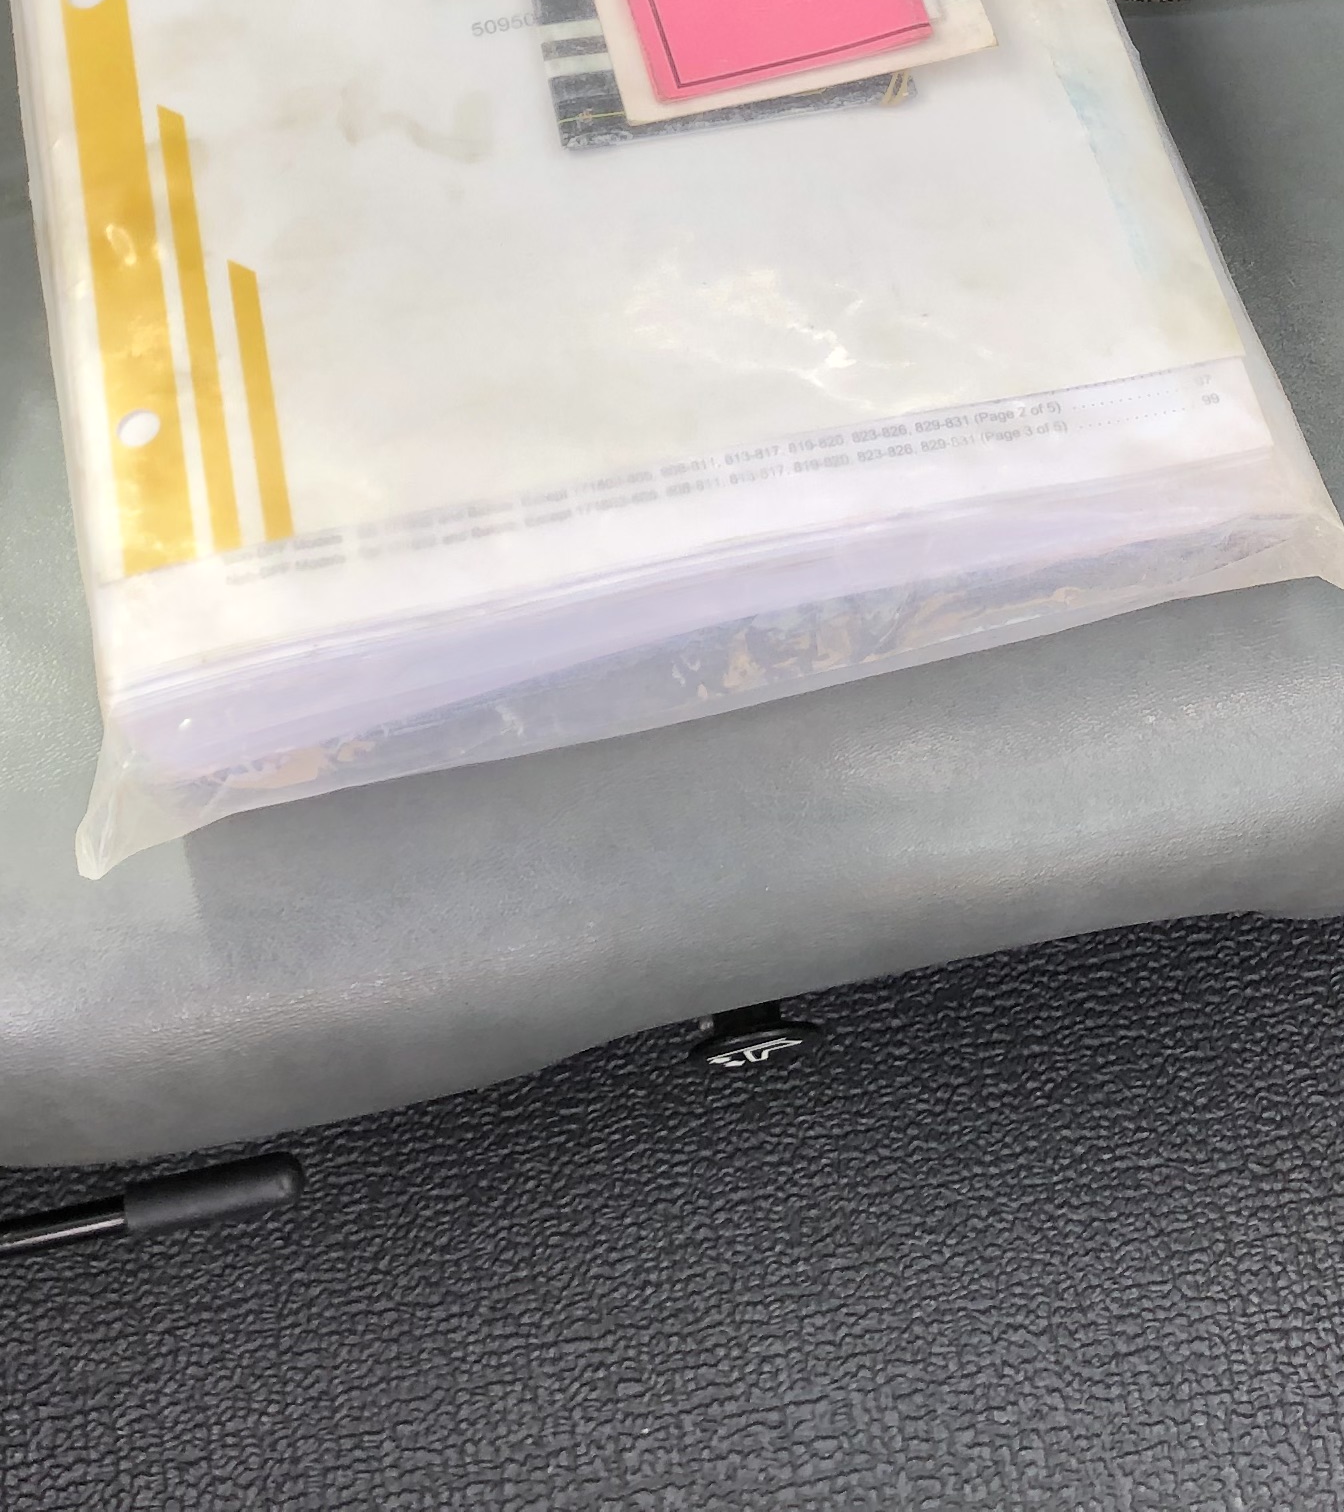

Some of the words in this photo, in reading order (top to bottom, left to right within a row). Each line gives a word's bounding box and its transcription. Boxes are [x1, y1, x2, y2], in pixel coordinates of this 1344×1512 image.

[915, 415, 969, 434] 829-831
[974, 408, 1015, 426] (Page
[1018, 406, 1027, 418] 2
[1030, 404, 1044, 416] of
[1046, 401, 1062, 415] 5)
[980, 428, 1021, 445] (Page
[1025, 426, 1033, 437] 3
[1036, 422, 1050, 435] of
[1201, 393, 1220, 406] 99
